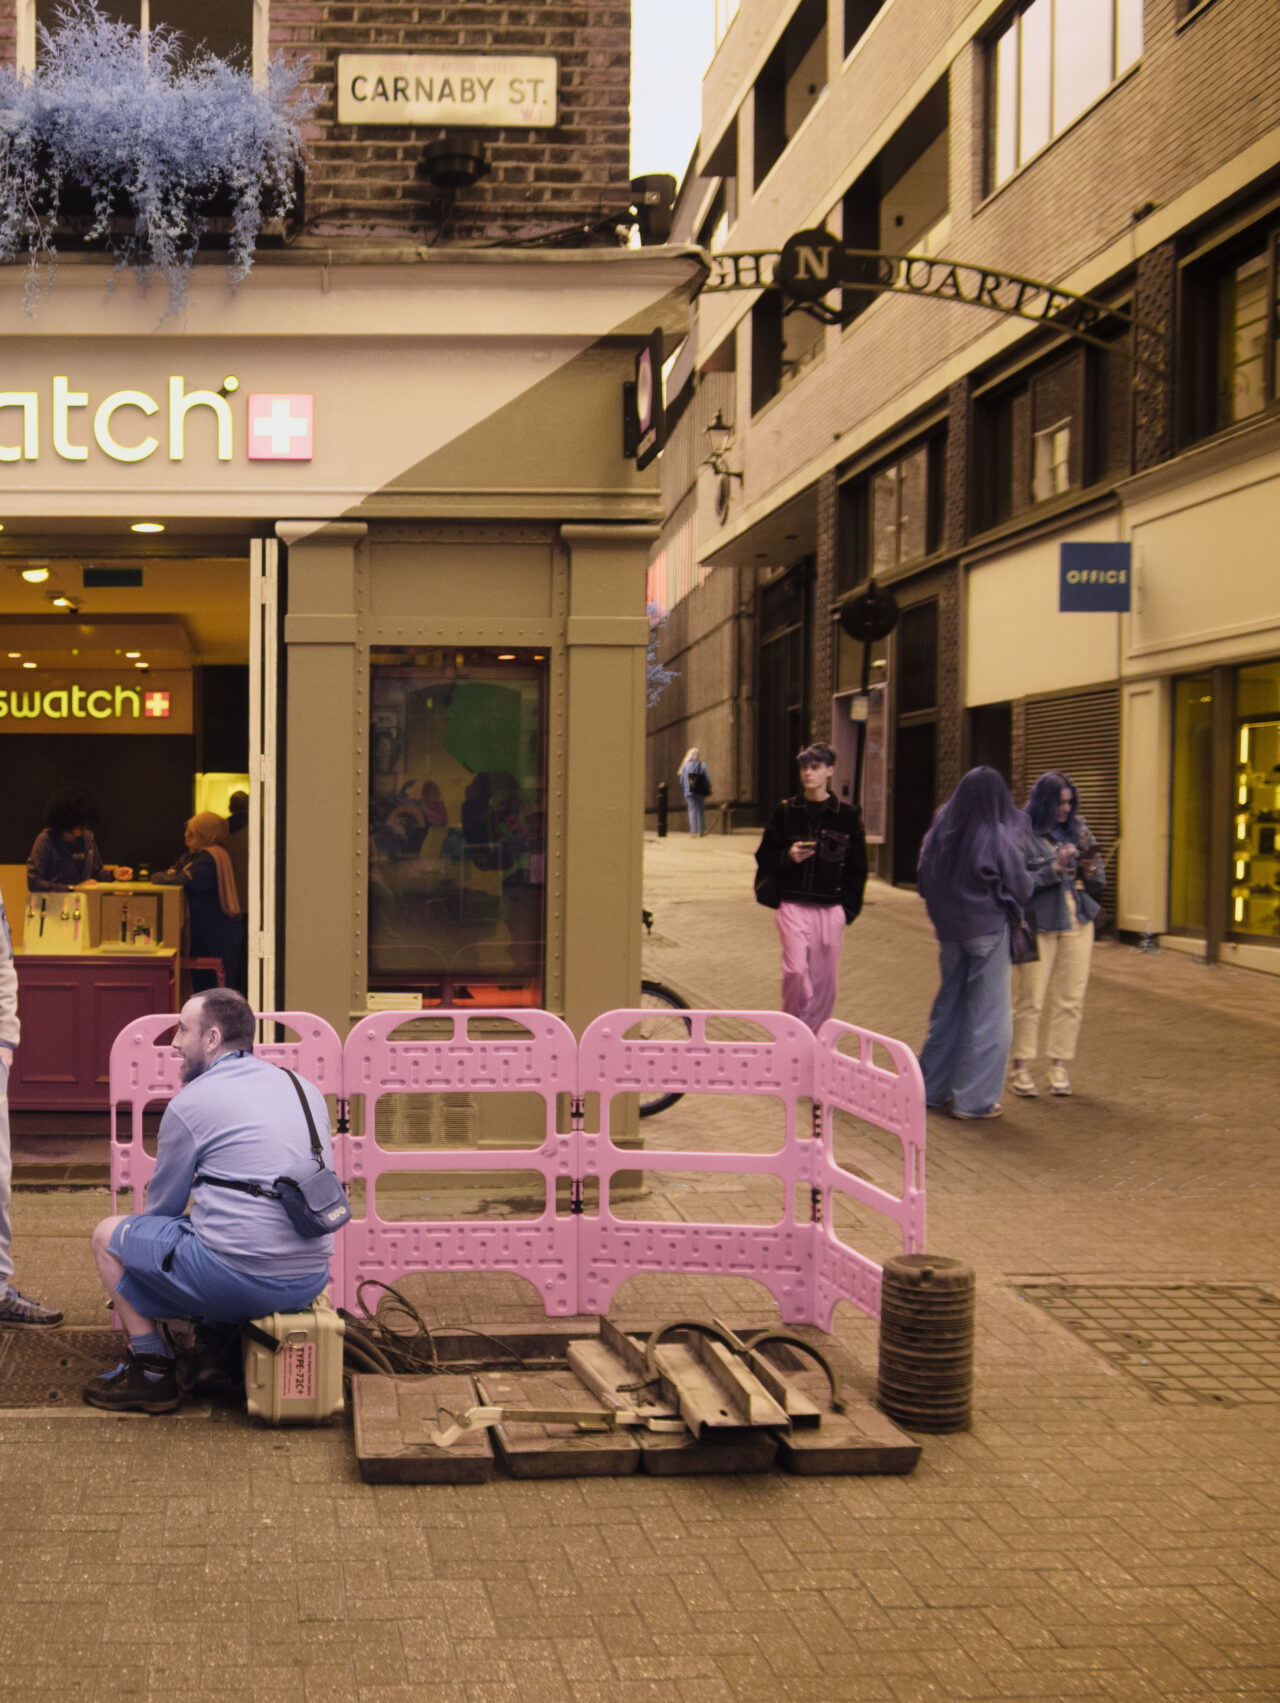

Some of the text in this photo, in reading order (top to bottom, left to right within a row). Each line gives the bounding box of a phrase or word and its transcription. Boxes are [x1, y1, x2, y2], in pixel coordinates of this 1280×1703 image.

[351, 75, 548, 105] CARNABY ST.
[793, 245, 833, 280] N
[1065, 569, 1129, 585] OFFICE
